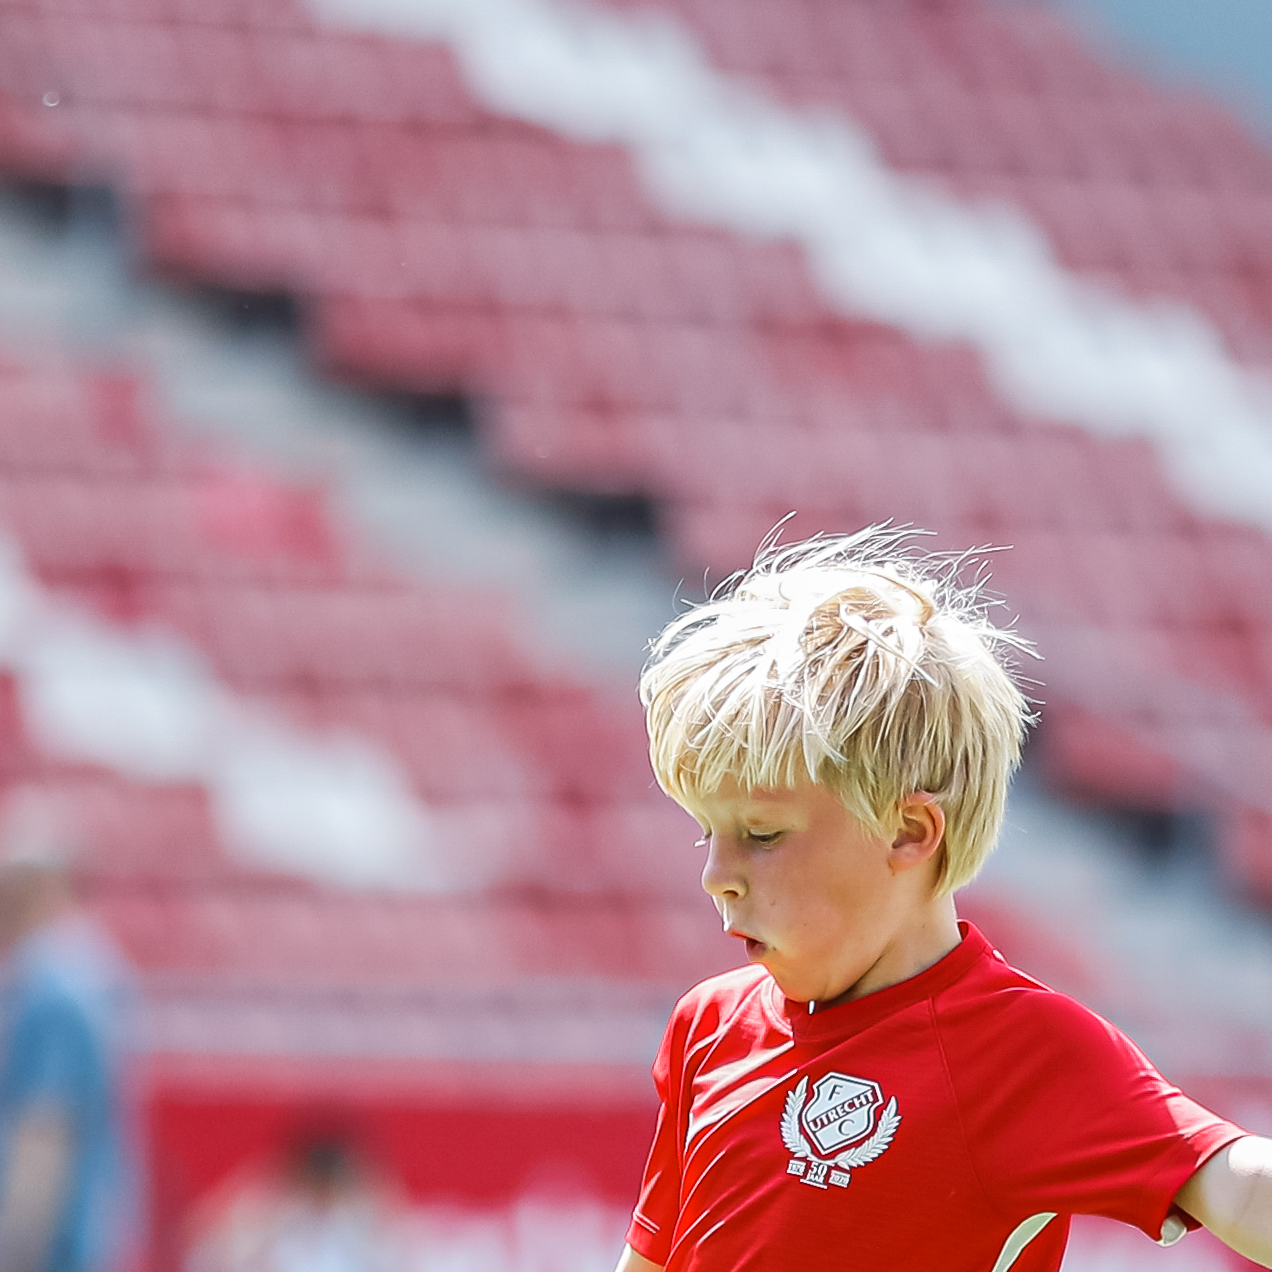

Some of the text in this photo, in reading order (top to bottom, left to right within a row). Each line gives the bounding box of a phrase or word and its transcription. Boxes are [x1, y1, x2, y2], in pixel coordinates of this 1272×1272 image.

[828, 1084, 844, 1101] F
[808, 1089, 875, 1131] UTRECHT
[838, 1118, 856, 1137] C
[811, 1161, 828, 1177] 50
